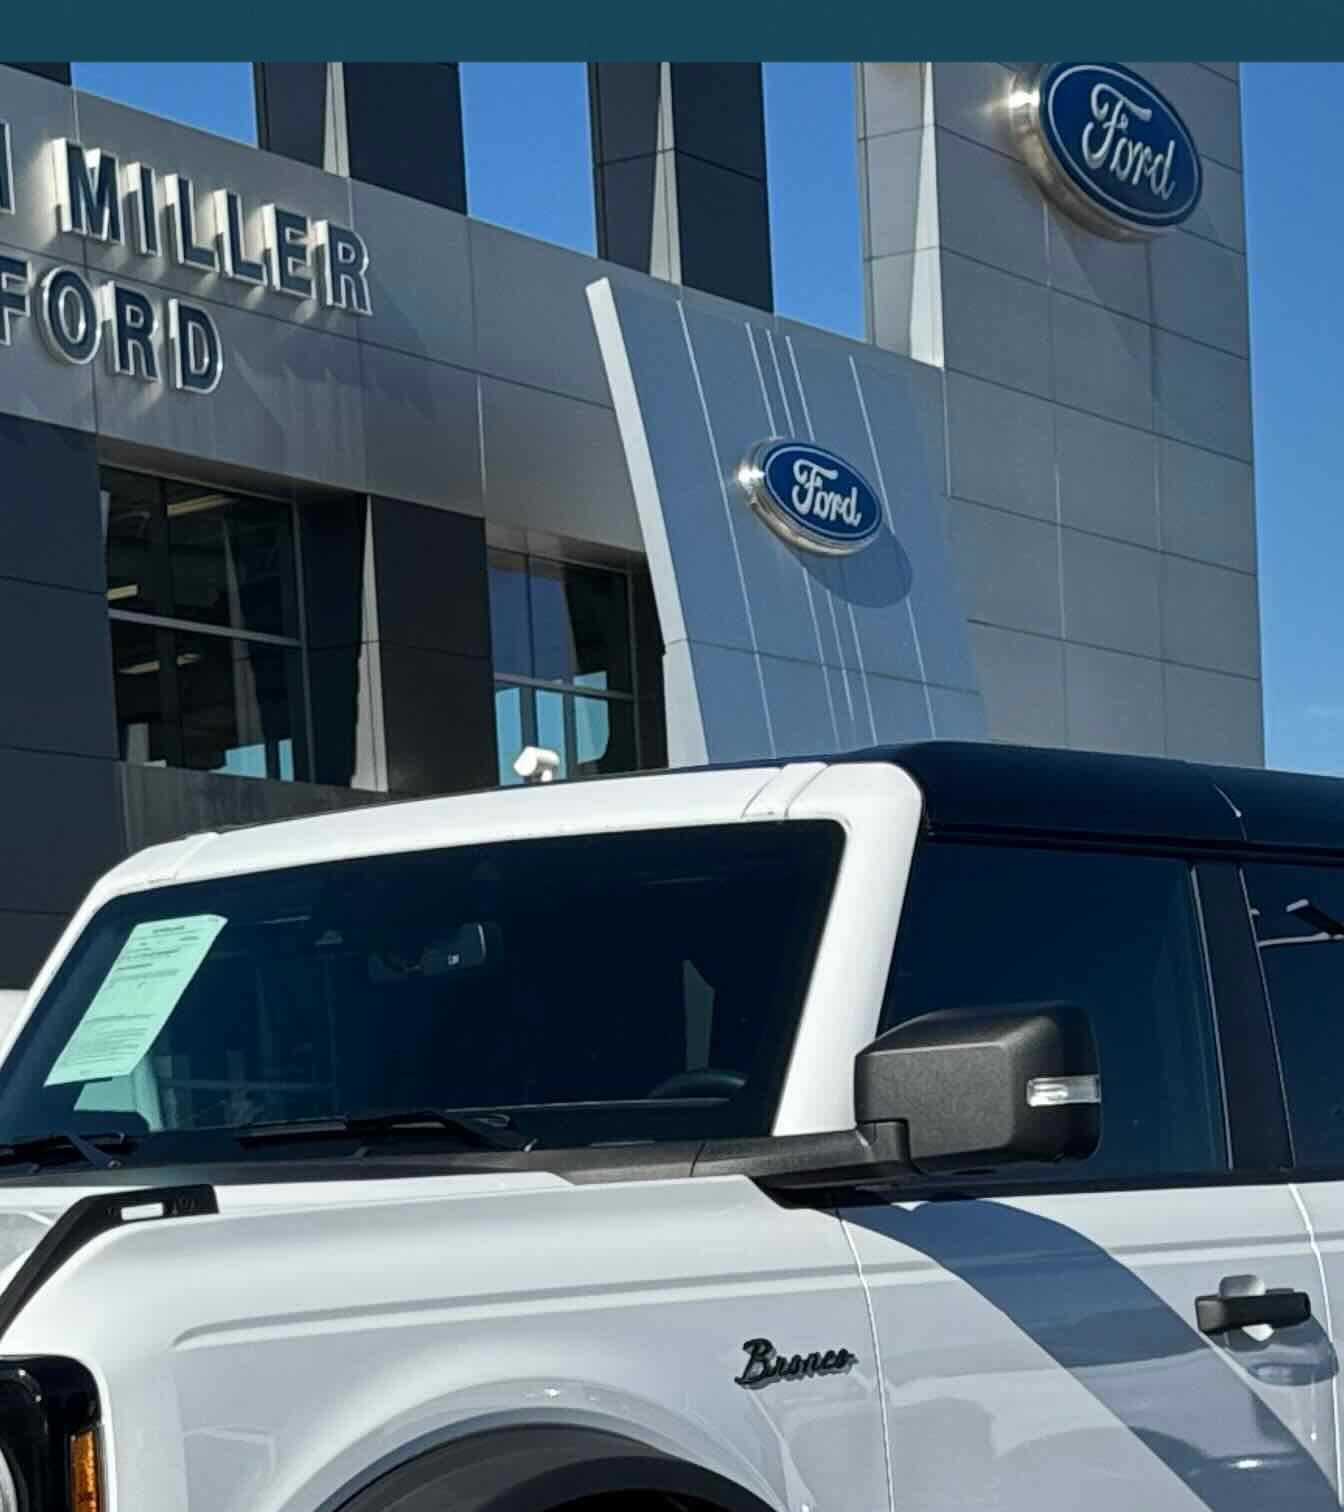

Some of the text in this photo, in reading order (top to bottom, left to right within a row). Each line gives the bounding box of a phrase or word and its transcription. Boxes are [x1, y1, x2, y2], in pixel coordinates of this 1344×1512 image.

[1081, 82, 1177, 200] Ford
[55, 137, 374, 317] MILLER
[792, 458, 863, 528] Ford
[734, 1337, 860, 1391] Bronco
